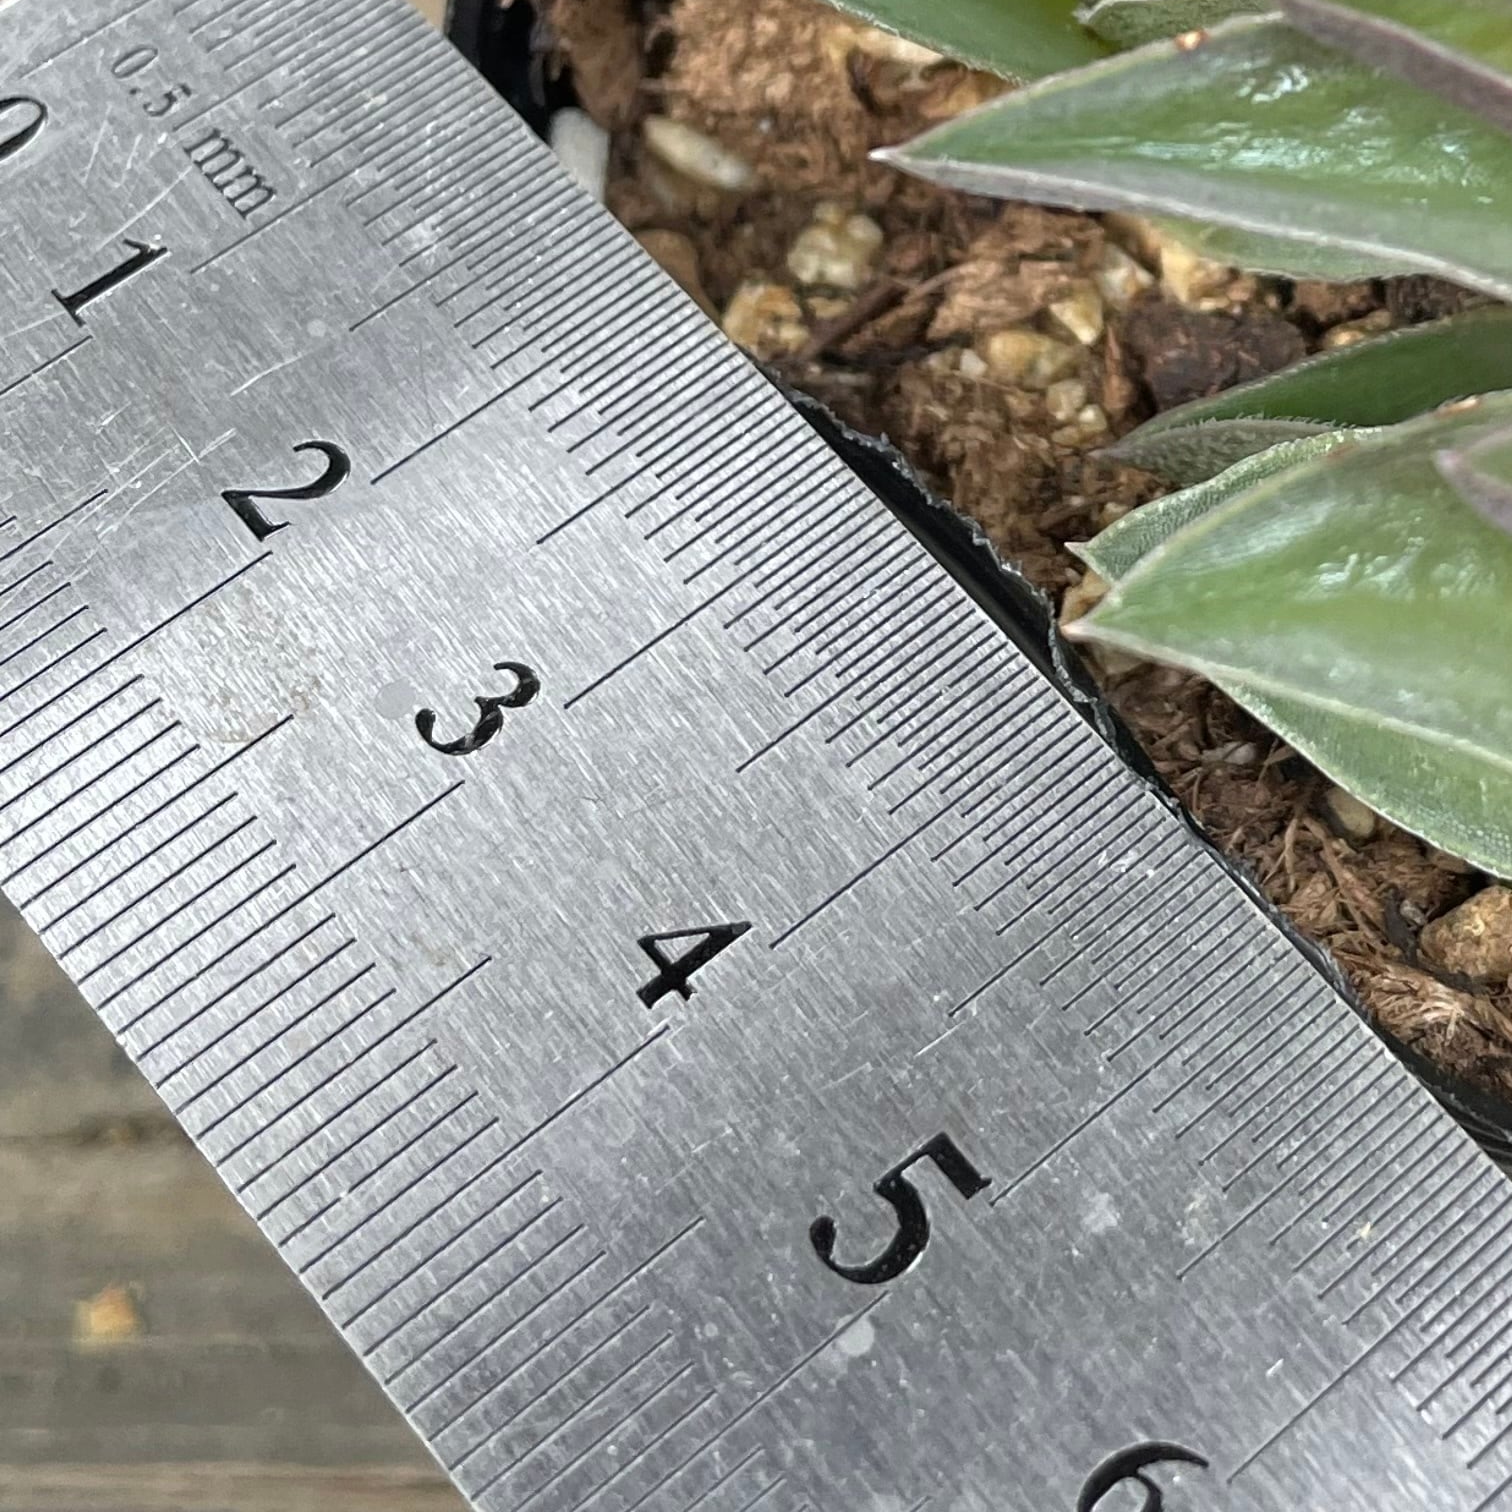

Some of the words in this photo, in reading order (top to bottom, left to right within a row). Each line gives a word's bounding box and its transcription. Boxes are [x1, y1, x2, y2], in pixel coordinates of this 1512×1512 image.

[111, 45, 193, 117] 0.5
[182, 127, 277, 220] mm
[51, 238, 168, 327] 1
[220, 440, 352, 542] 2
[415, 660, 541, 756] 3
[636, 920, 753, 1009] 4
[808, 1131, 993, 1285] 5
